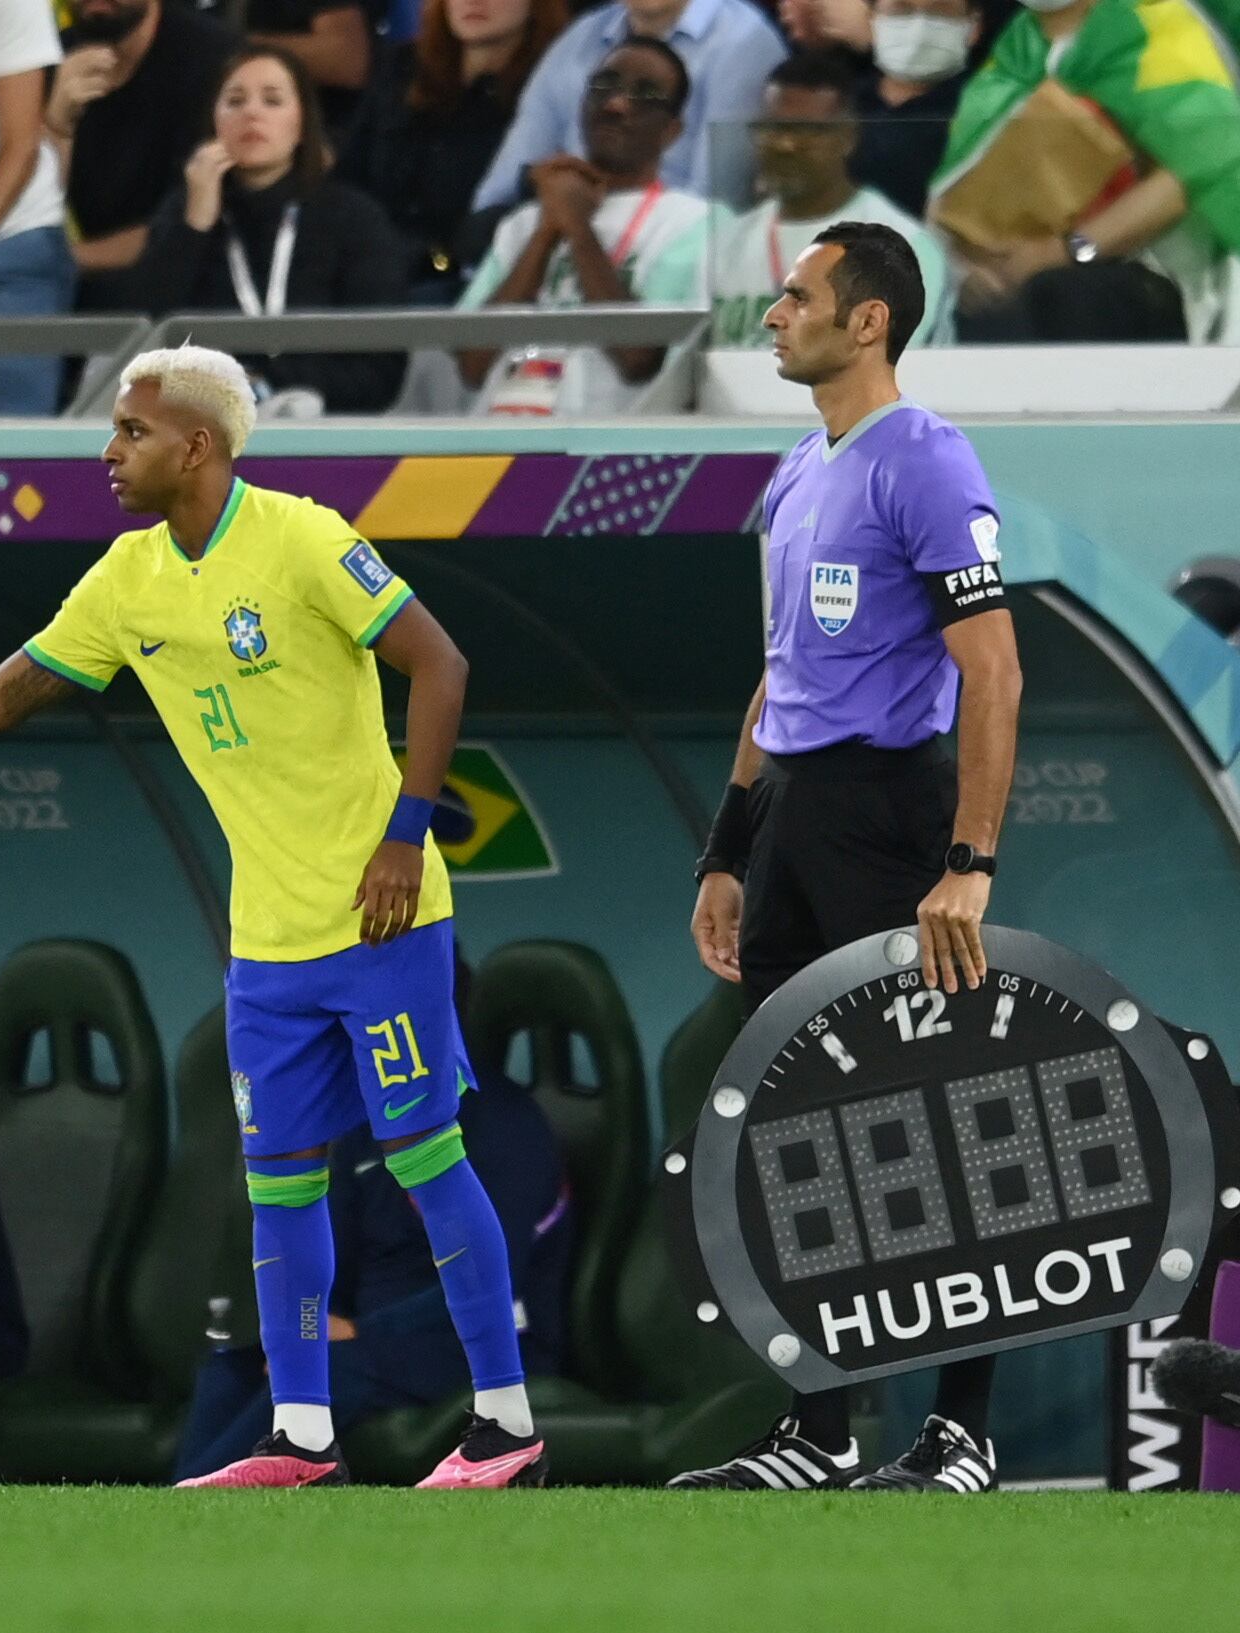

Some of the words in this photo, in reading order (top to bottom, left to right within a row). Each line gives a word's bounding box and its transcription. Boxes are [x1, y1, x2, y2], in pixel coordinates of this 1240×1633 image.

[815, 567, 852, 586] FIFA
[944, 564, 999, 594] FIFA
[814, 595, 853, 606] REFEREE
[955, 589, 986, 607] TEAM
[237, 659, 282, 678] BRASIL
[193, 683, 249, 752] 21
[897, 971, 920, 990] 60
[998, 973, 1021, 992] 05
[807, 1014, 830, 1036] 55
[882, 989, 953, 1042] 12
[365, 1011, 430, 1089] 21
[818, 1236, 1132, 1355] HUBLOT
[300, 1293, 321, 1340] BRASIL
